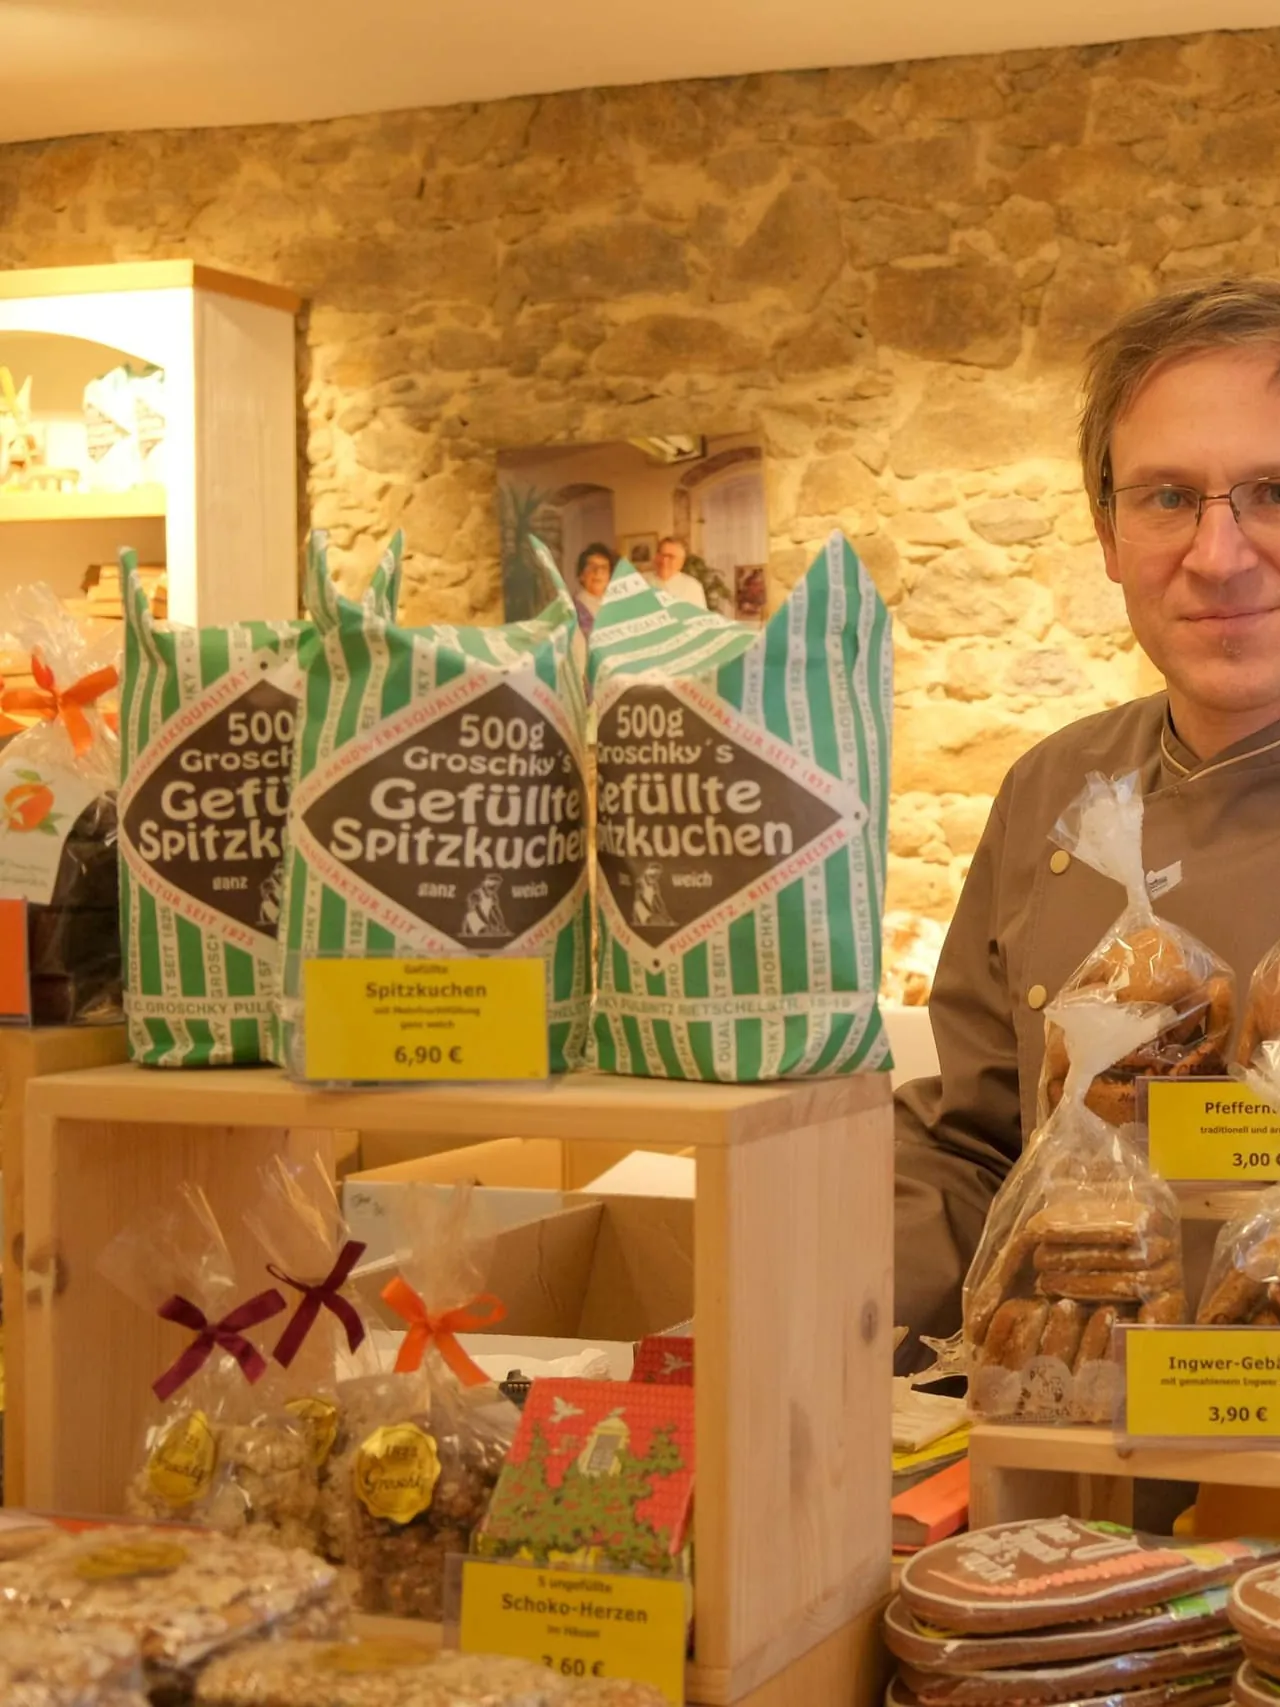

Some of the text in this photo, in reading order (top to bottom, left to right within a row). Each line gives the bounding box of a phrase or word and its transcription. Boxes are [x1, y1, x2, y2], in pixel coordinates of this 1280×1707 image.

[458, 713, 545, 751] 500g
[616, 704, 684, 739] 500g
[369, 777, 580, 826] Gefüllte
[598, 773, 762, 815] efüllte
[671, 870, 713, 888] weich
[418, 882, 548, 899] ganz weich
[668, 905, 738, 955] PULSNITZ
[165, 945, 177, 978] SEIT
[365, 981, 488, 1001] Spitzkuchen
[394, 1045, 464, 1067] 6,90 €
[1205, 1101, 1277, 1115] Pfeffern
[1200, 1126, 1249, 1134] traditionell
[1251, 1126, 1268, 1134] und
[1233, 1152, 1271, 1169] 3,00
[1160, 1377, 1176, 1386] mit
[1243, 1377, 1277, 1388] Ingwer
[1208, 1406, 1268, 1424] 3,90 €
[549, 1577, 613, 1594] ungefüllte
[501, 1593, 649, 1624] Schoko-Herzen
[541, 1655, 606, 1678] 360 €
